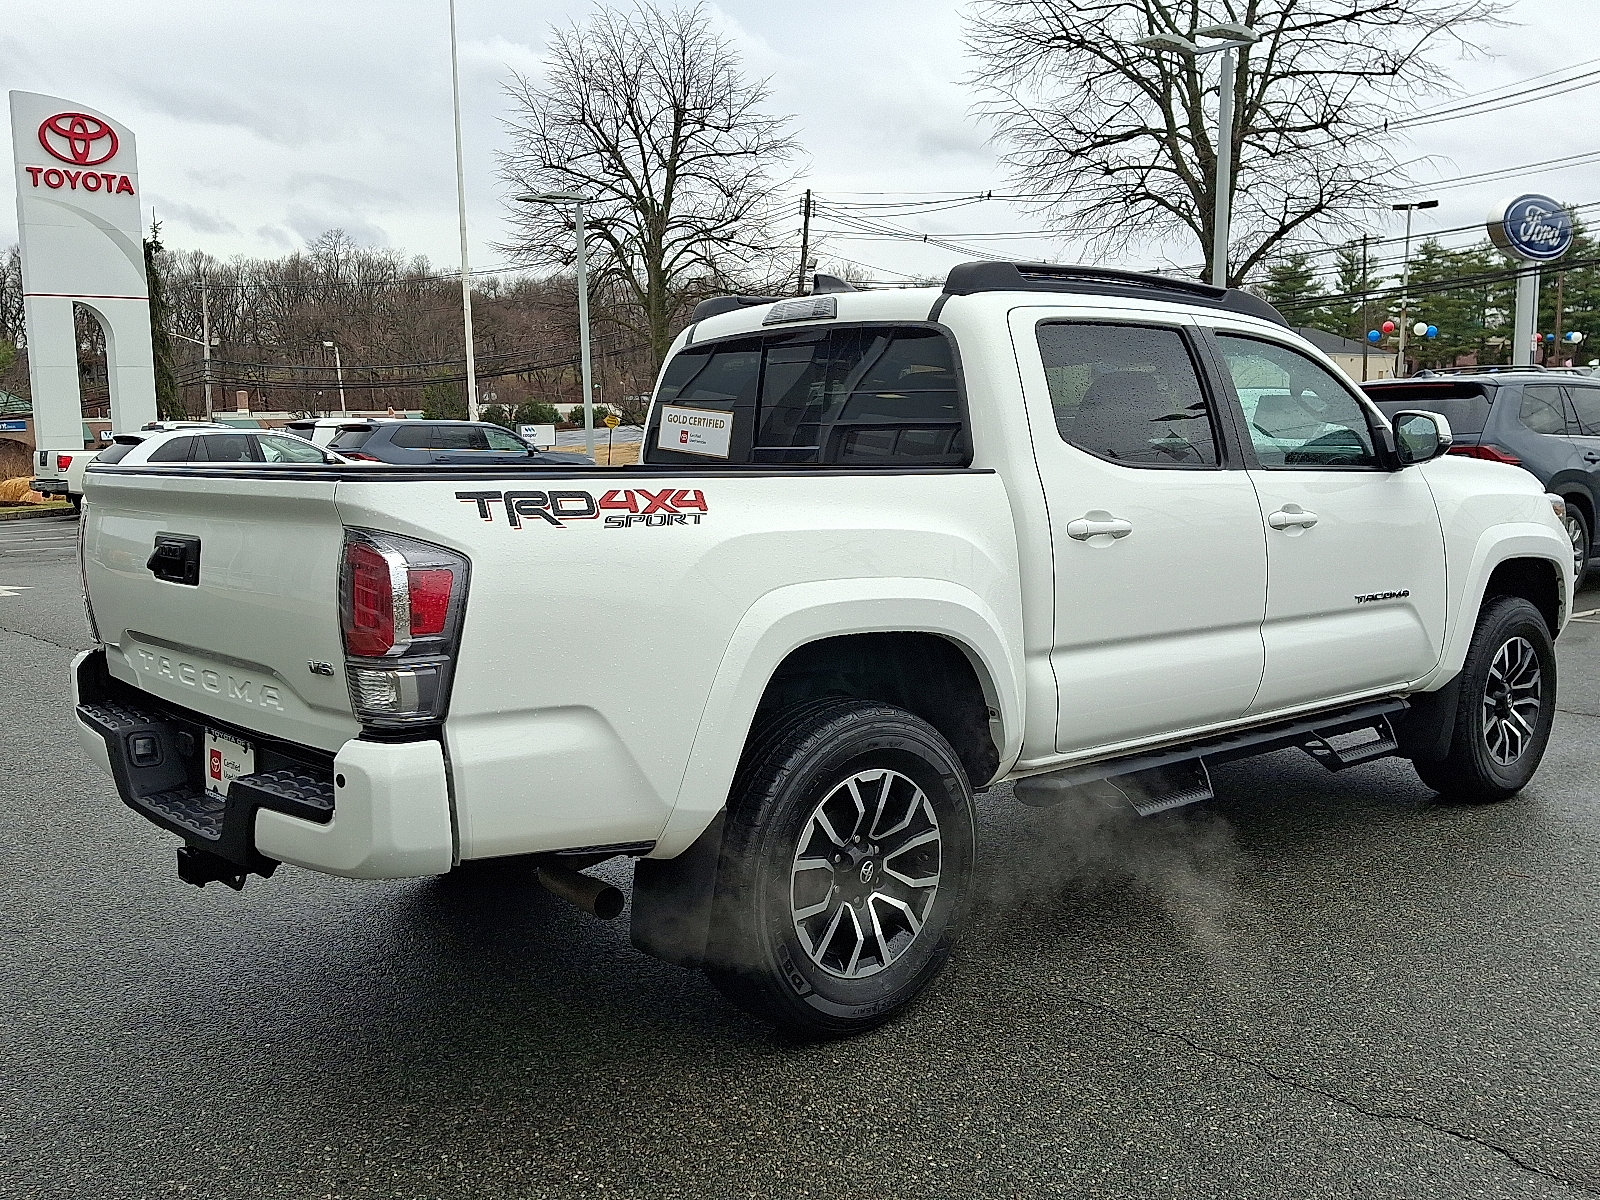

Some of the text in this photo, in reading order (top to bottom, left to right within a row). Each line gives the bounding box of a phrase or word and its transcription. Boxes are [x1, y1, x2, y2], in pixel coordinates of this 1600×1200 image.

[26, 166, 135, 196] TOYOTA
[1520, 204, 1563, 247] Ford
[667, 413, 725, 429] GOLD CERTIFIED
[455, 490, 600, 530] TRD
[604, 512, 708, 529] SPORT
[1354, 589, 1410, 604] TACOMA
[138, 648, 285, 713] TACOMA
[210, 729, 236, 744] TOYOTA
[223, 758, 241, 773] Certified
